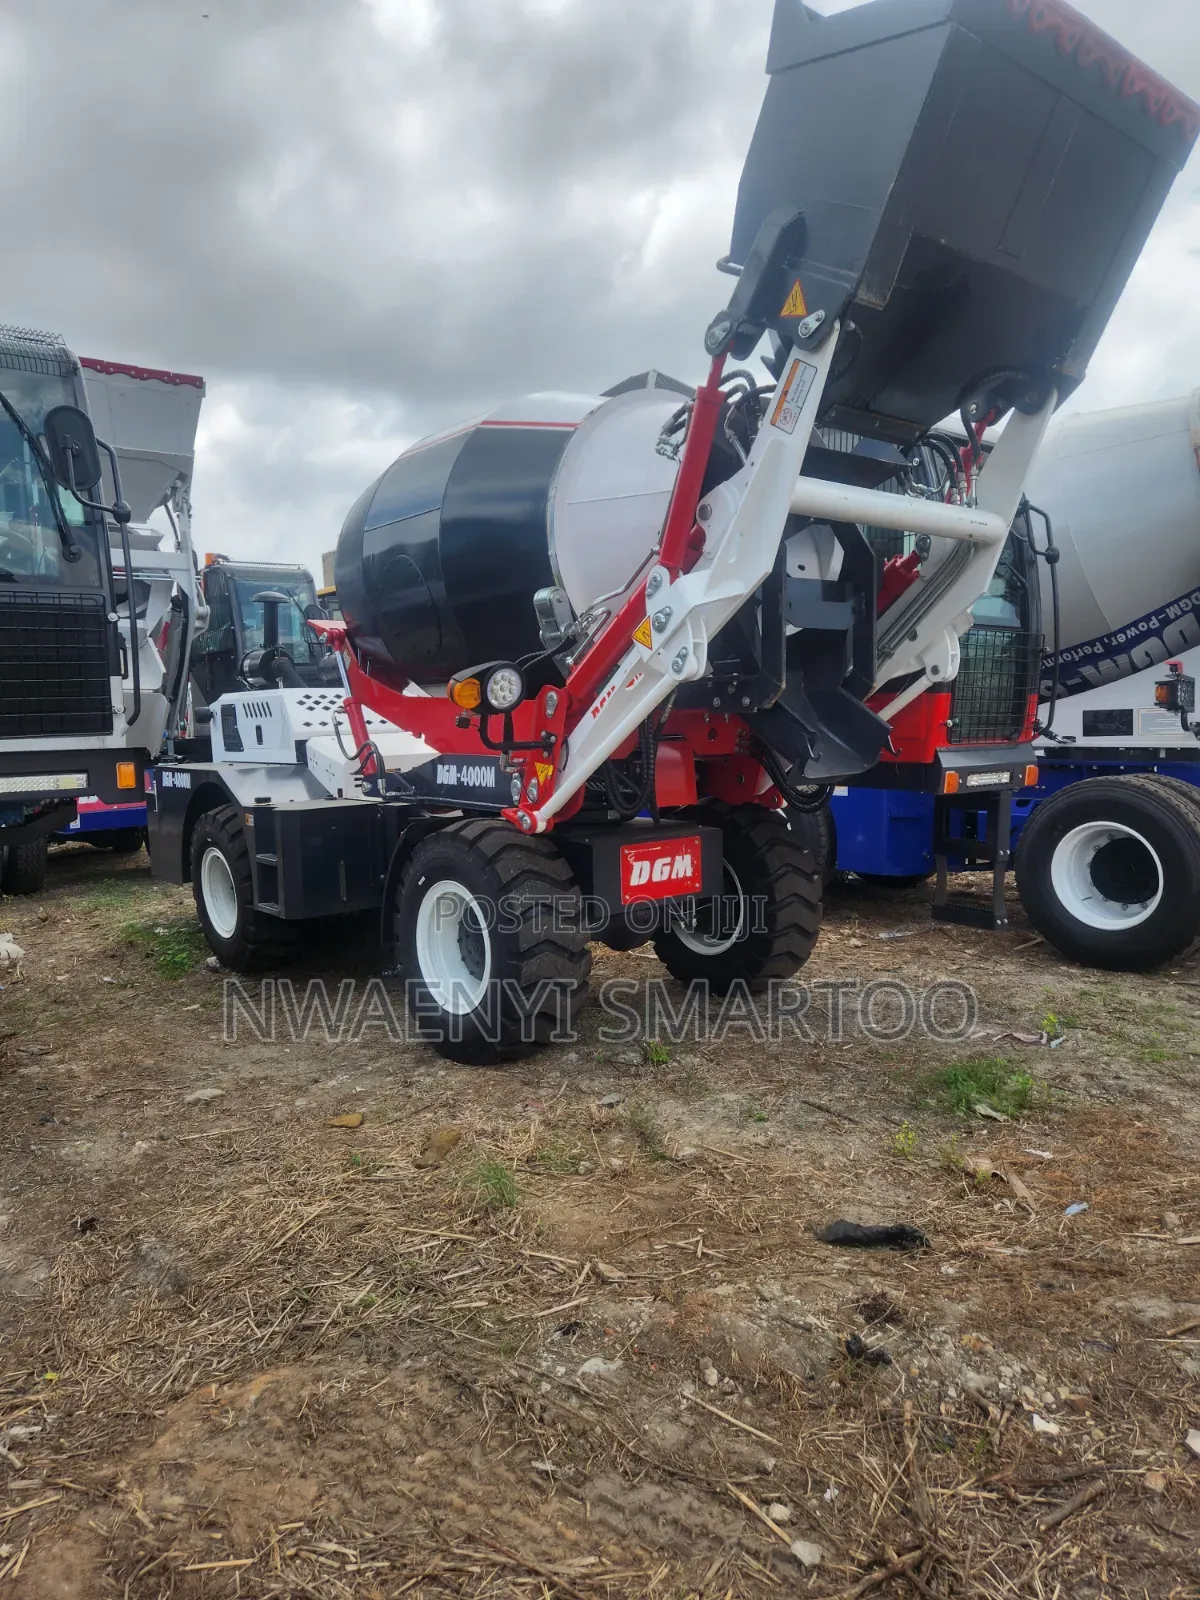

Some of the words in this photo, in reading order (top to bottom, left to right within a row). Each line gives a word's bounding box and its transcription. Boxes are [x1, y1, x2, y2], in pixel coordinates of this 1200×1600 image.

[1042, 641, 1105, 669] Perform
[437, 764, 495, 788] DGM-4000M
[630, 854, 693, 887] DGM
